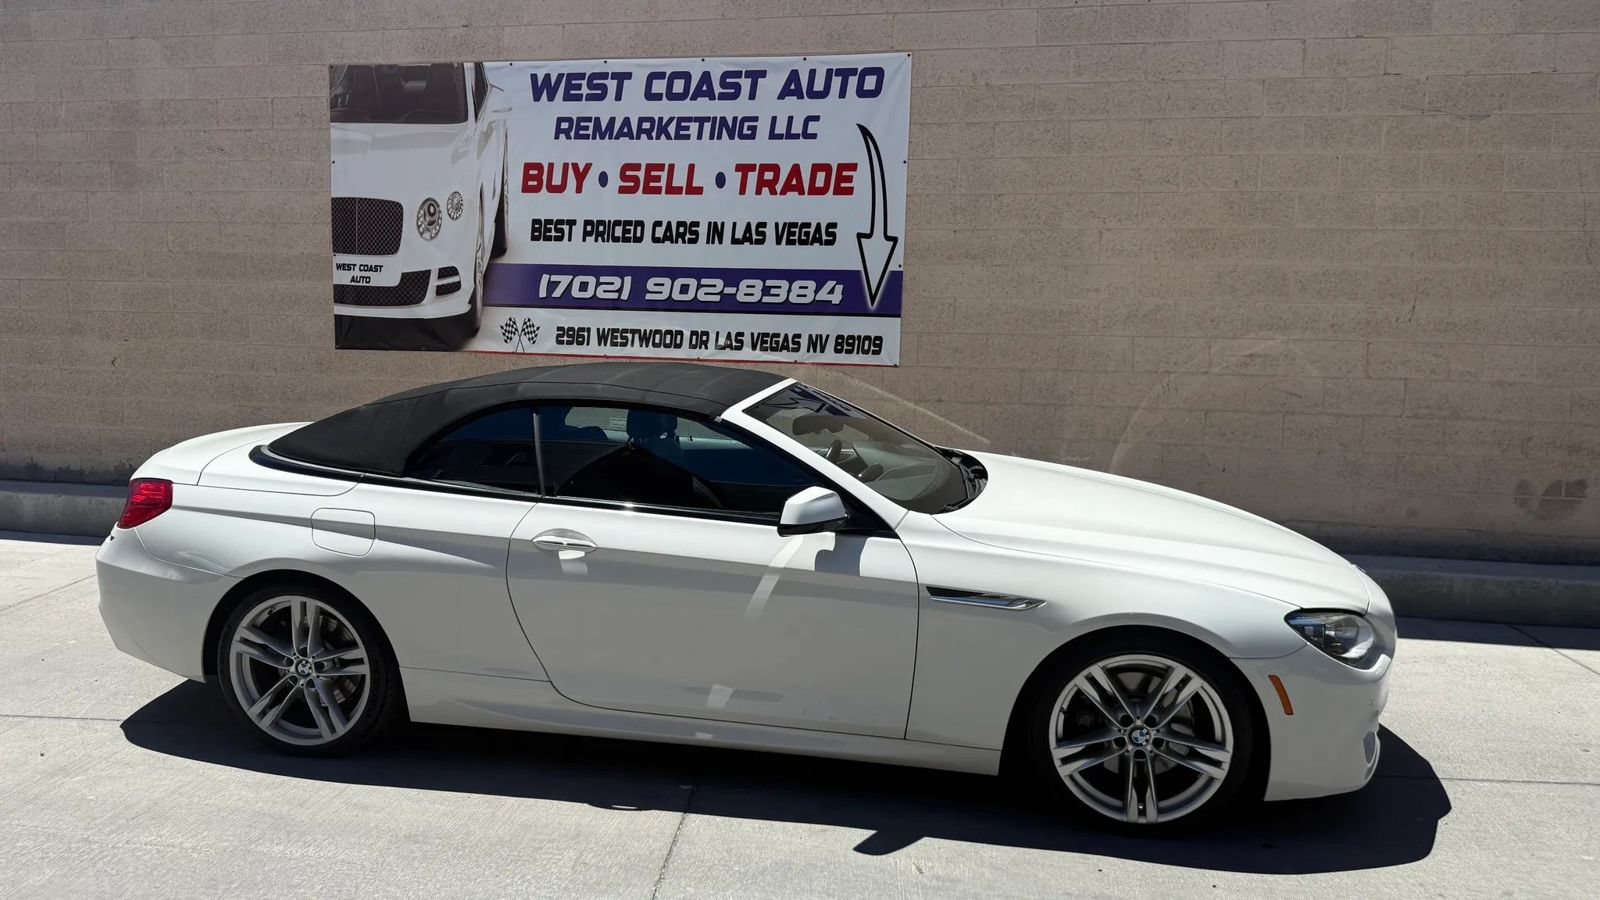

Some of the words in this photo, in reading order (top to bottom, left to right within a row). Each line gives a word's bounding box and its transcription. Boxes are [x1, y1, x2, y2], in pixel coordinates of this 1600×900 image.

[530, 71, 632, 102] WEST
[644, 69, 767, 102] COAST
[777, 66, 885, 100] AUTO
[554, 116, 759, 140] REMARKETING
[768, 115, 820, 140] LLC
[521, 162, 592, 194] BUY
[618, 163, 704, 195] SELL
[734, 162, 858, 196] TRADE
[530, 218, 576, 242] BEST
[582, 220, 645, 244] PRICED
[651, 220, 700, 244] CARS
[706, 221, 725, 244] IN
[730, 222, 767, 246] LAS
[774, 222, 838, 246] VEGAS
[335, 263, 357, 271] WEST
[358, 264, 384, 273] COAST
[350, 275, 371, 284] AUTO
[538, 274, 632, 300] (702)
[645, 277, 844, 305] 902-8384
[556, 326, 591, 346] 2961
[596, 328, 684, 349] WESTWOOD
[688, 330, 710, 350] DR
[714, 331, 744, 350] LAS
[750, 332, 802, 352] VEGAS
[806, 334, 830, 353] NV
[834, 334, 884, 355] 89109
